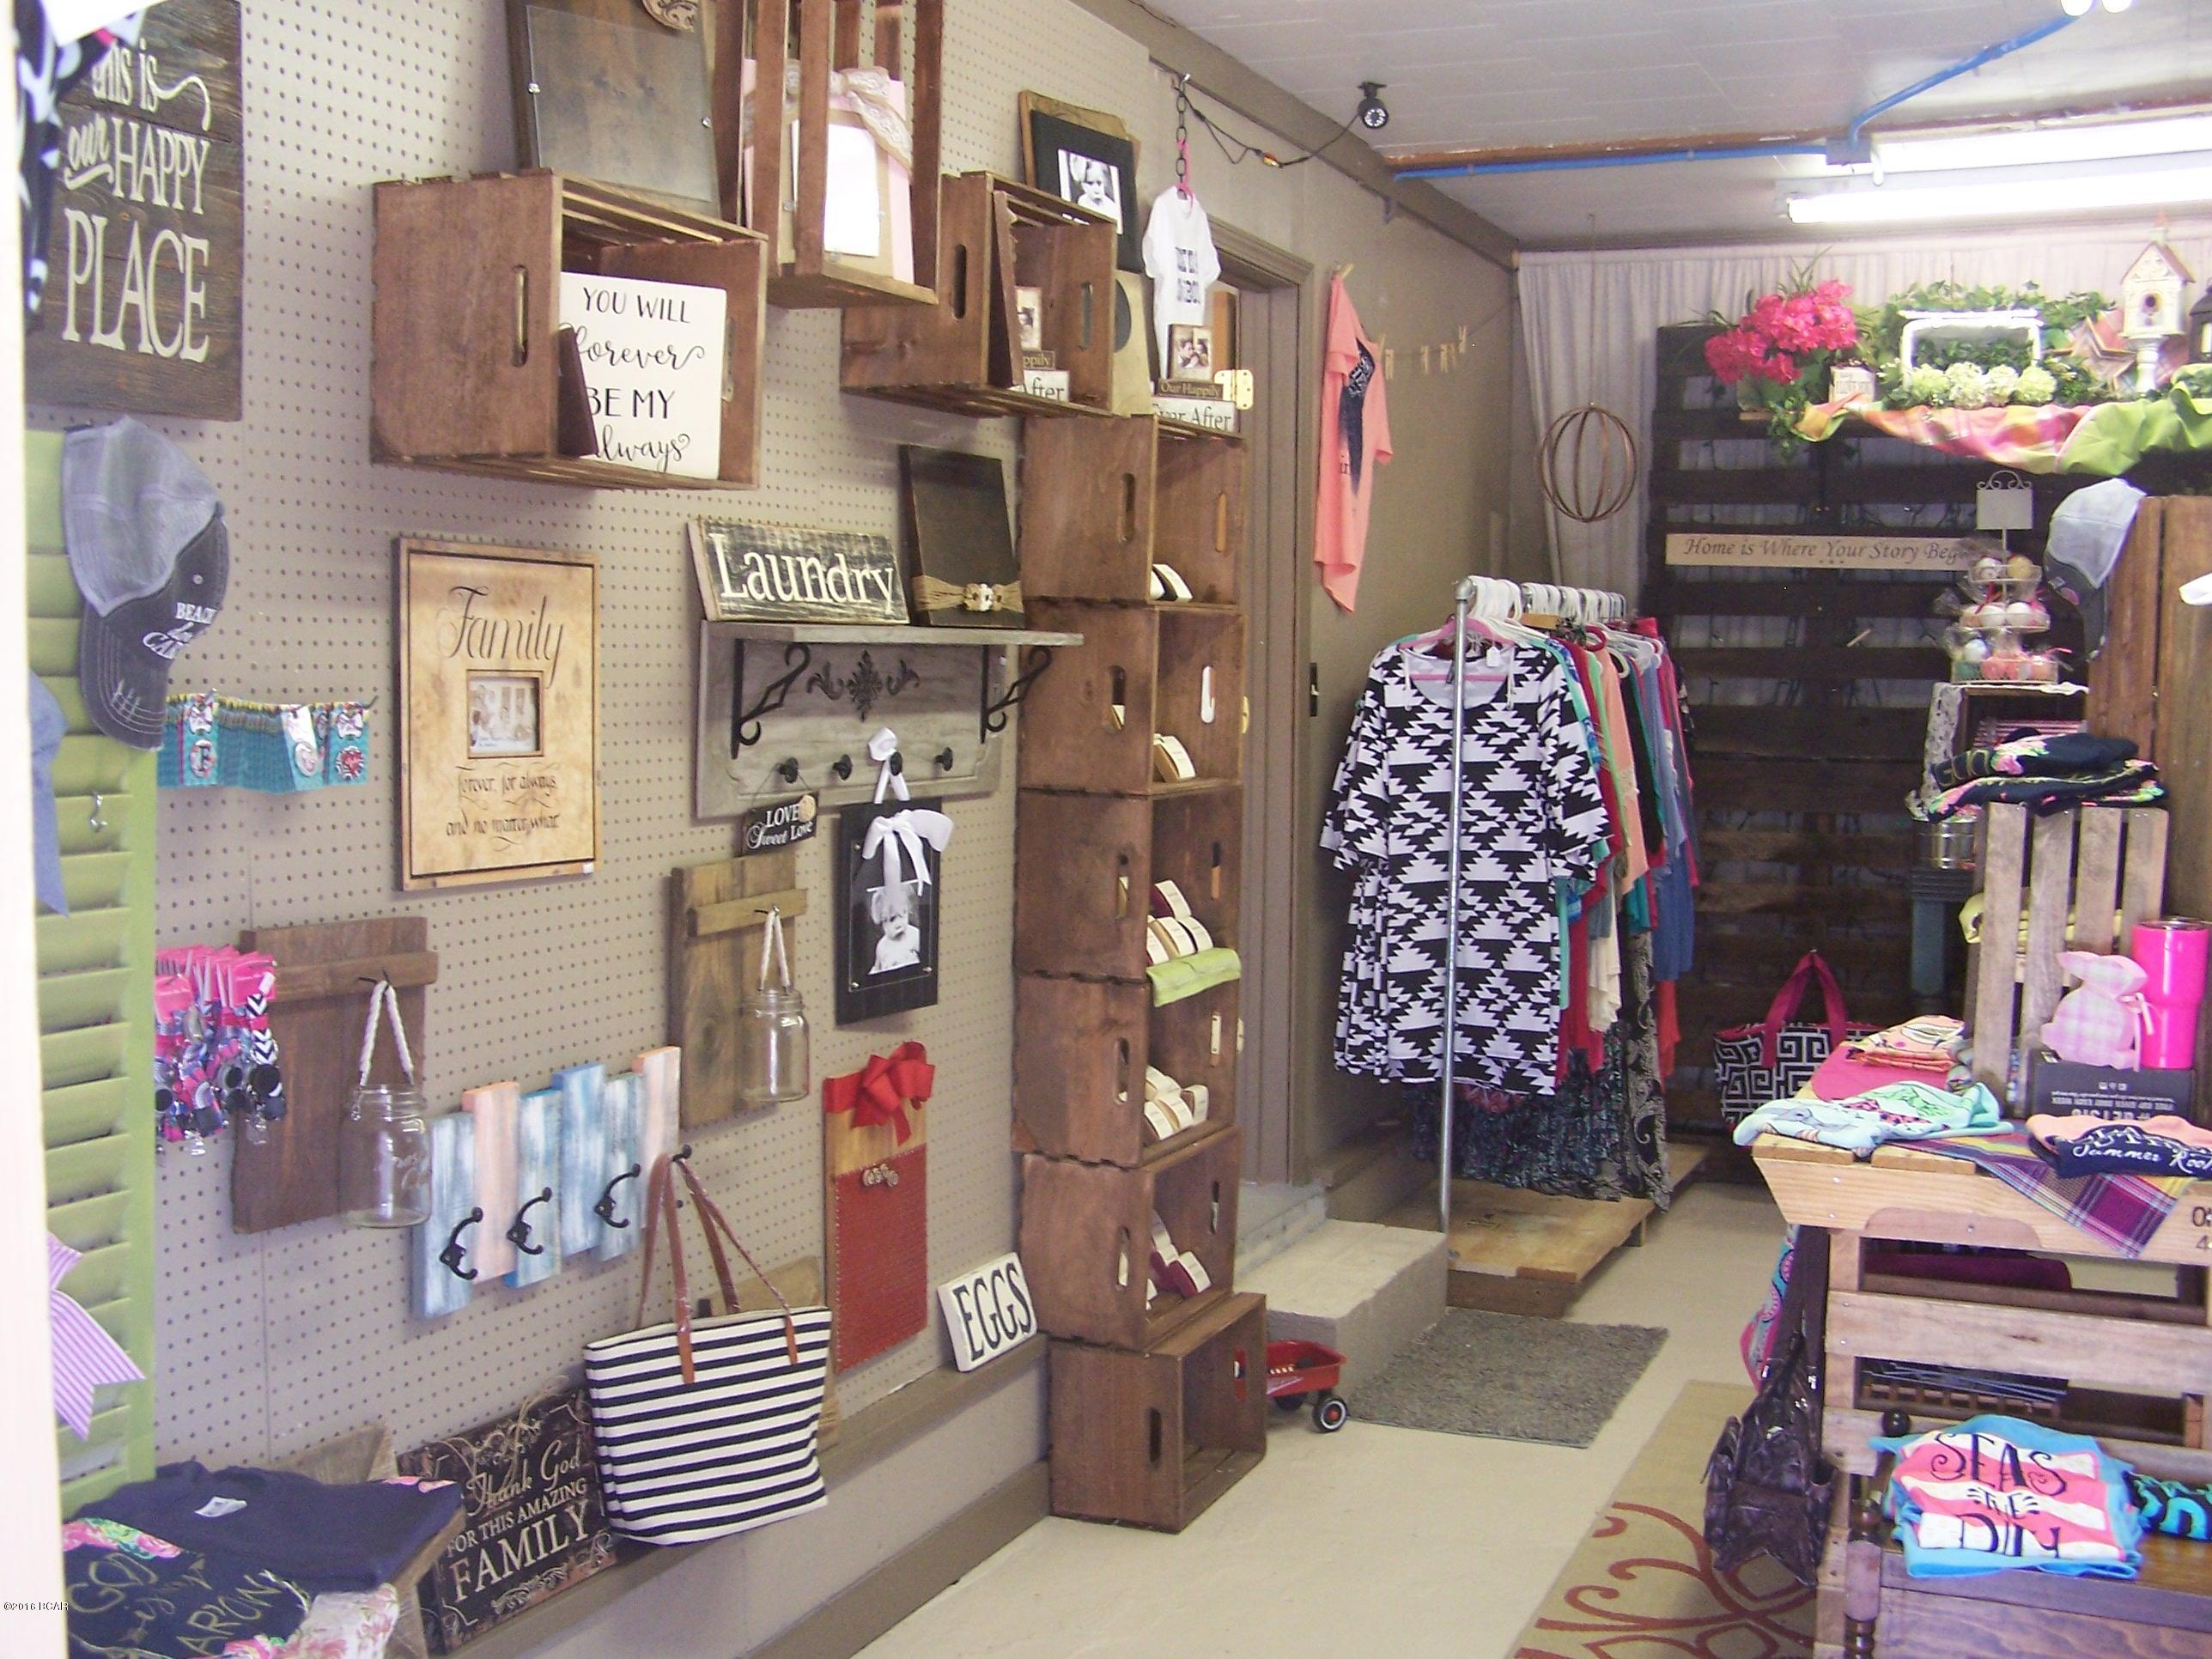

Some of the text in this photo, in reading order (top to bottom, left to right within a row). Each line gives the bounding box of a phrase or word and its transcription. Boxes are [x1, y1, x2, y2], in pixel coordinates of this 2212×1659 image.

[65, 112, 211, 215] our HAPPY
[63, 208, 210, 362] PLACE
[583, 287, 691, 324] YOU WILL
[586, 387, 676, 420] BE MY
[1022, 376, 1065, 401] fter
[1192, 405, 1231, 432] After
[596, 424, 690, 473] lways
[709, 532, 894, 616] Laundry
[1684, 538, 1735, 556] Home
[1741, 538, 1754, 556] is
[1761, 538, 1816, 556] Where
[1827, 540, 1866, 558] Your
[1869, 543, 1919, 565] Story
[438, 585, 564, 689] Family
[765, 803, 799, 828] LOVE
[952, 1262, 1031, 1362] EGGS
[465, 1432, 581, 1517] Thank God
[1930, 1432, 2068, 1497] SEAS
[447, 1476, 588, 1559] FOR THIS AMAZING
[448, 1498, 590, 1604] FAMILY
